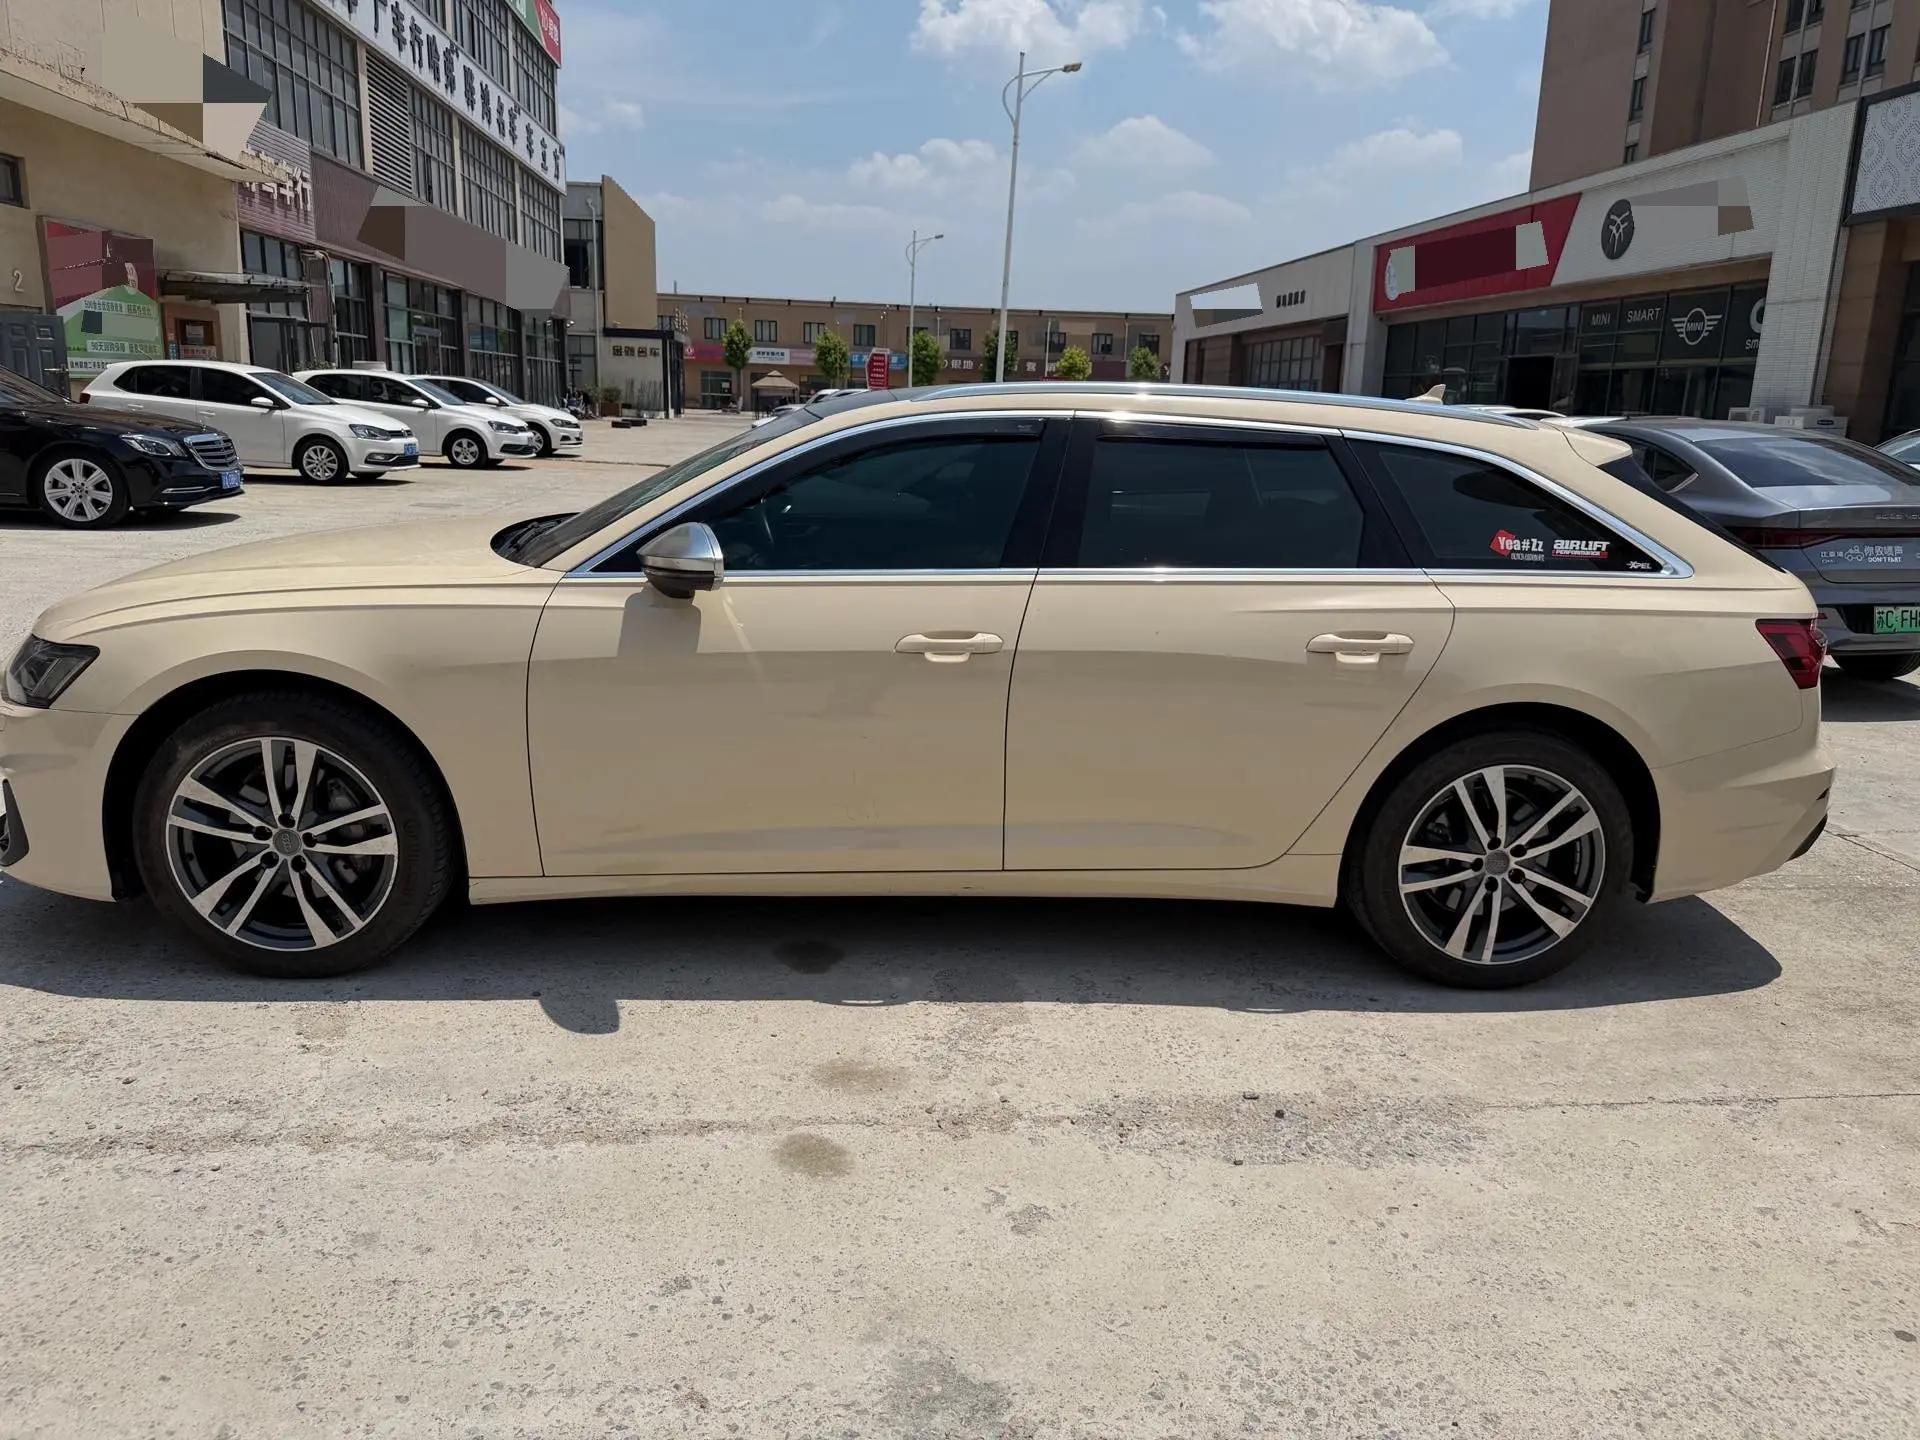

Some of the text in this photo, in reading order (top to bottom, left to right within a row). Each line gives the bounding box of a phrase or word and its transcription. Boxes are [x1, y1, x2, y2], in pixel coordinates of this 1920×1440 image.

[12, 269, 25, 293] 2
[1590, 307, 1661, 326] MINI SMART
[1685, 321, 1704, 333] MINI
[1629, 560, 1652, 569] XPEL
